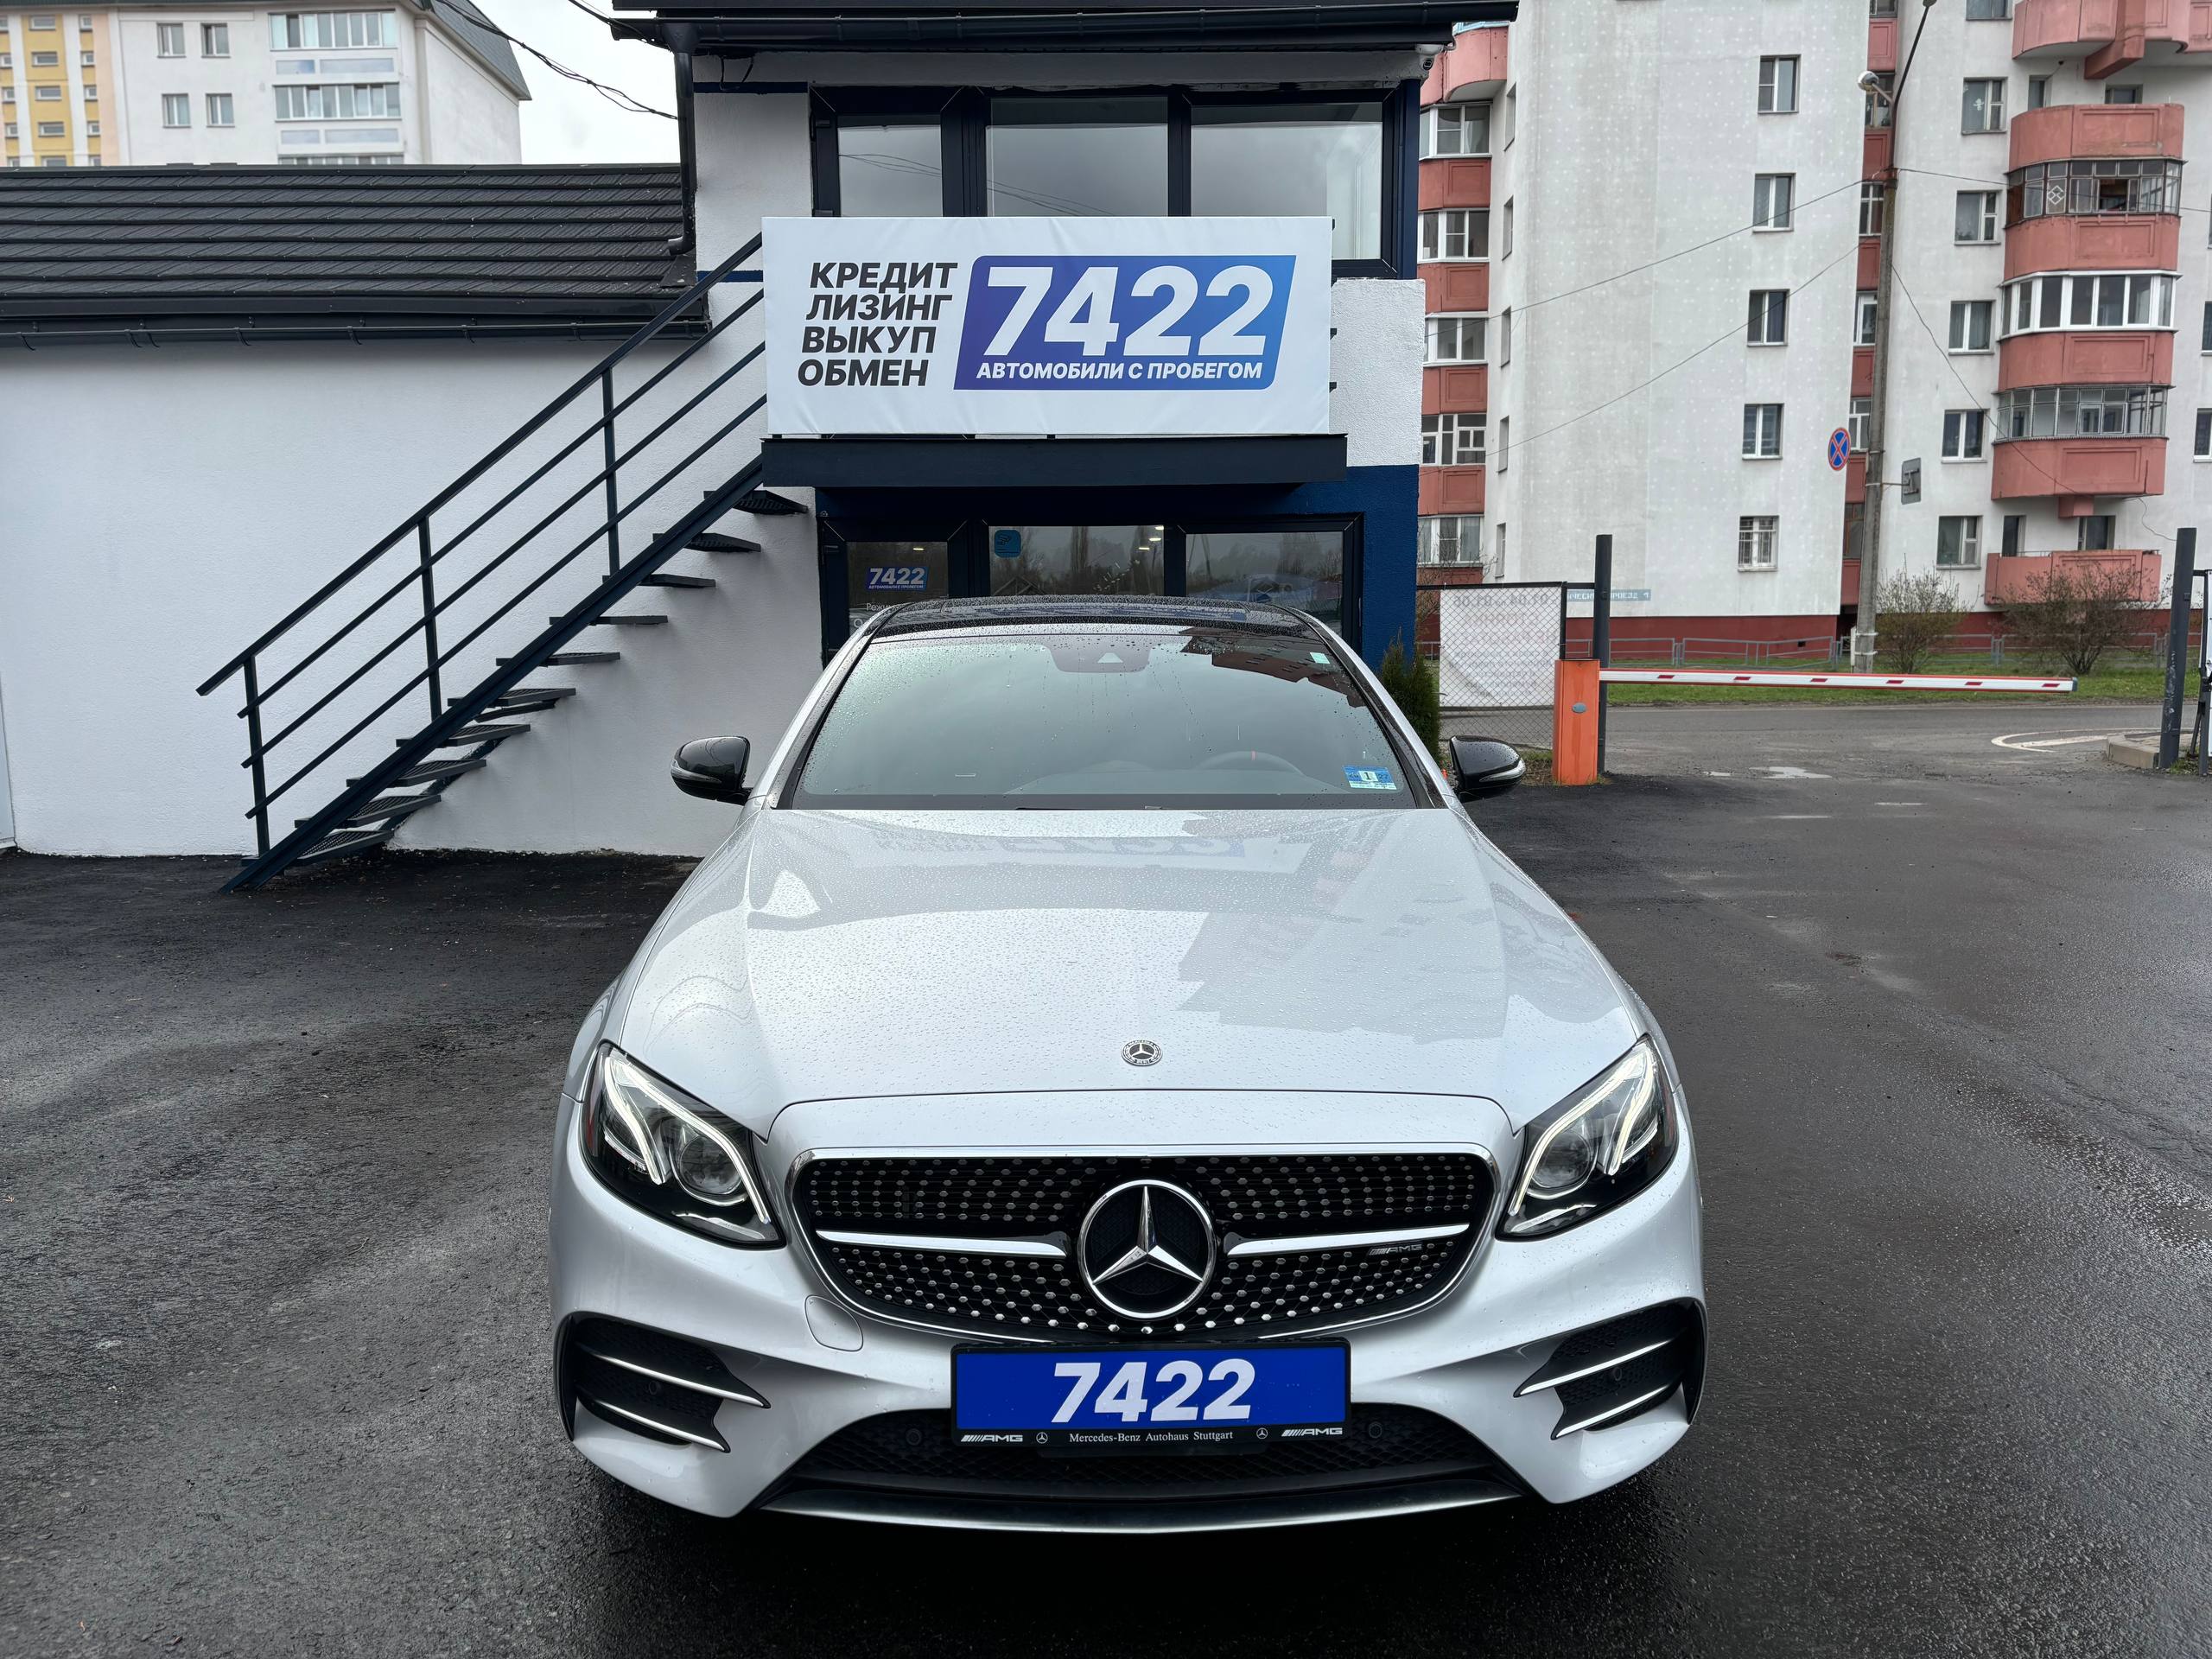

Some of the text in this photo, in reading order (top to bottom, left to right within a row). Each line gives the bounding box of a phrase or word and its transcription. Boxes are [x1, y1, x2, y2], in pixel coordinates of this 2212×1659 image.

[809, 262, 958, 291] КРЕДИТ
[805, 295, 953, 321] ЛИЗИНГ
[983, 264, 1274, 356] 7422
[801, 326, 936, 353] ВЫКУП
[798, 359, 928, 387] ОБМЕН
[976, 362, 1262, 380] АВТОМОБИЛИ С ПРОБЕГОМ
[870, 568, 925, 584] 7422
[1364, 772, 1372, 780] 1
[1051, 1358, 1255, 1423] 7422
[1069, 1432, 1141, 1443] Mercedes-Benz
[1146, 1431, 1189, 1441] Autohaus
[1193, 1430, 1234, 1442] Stuttgart
